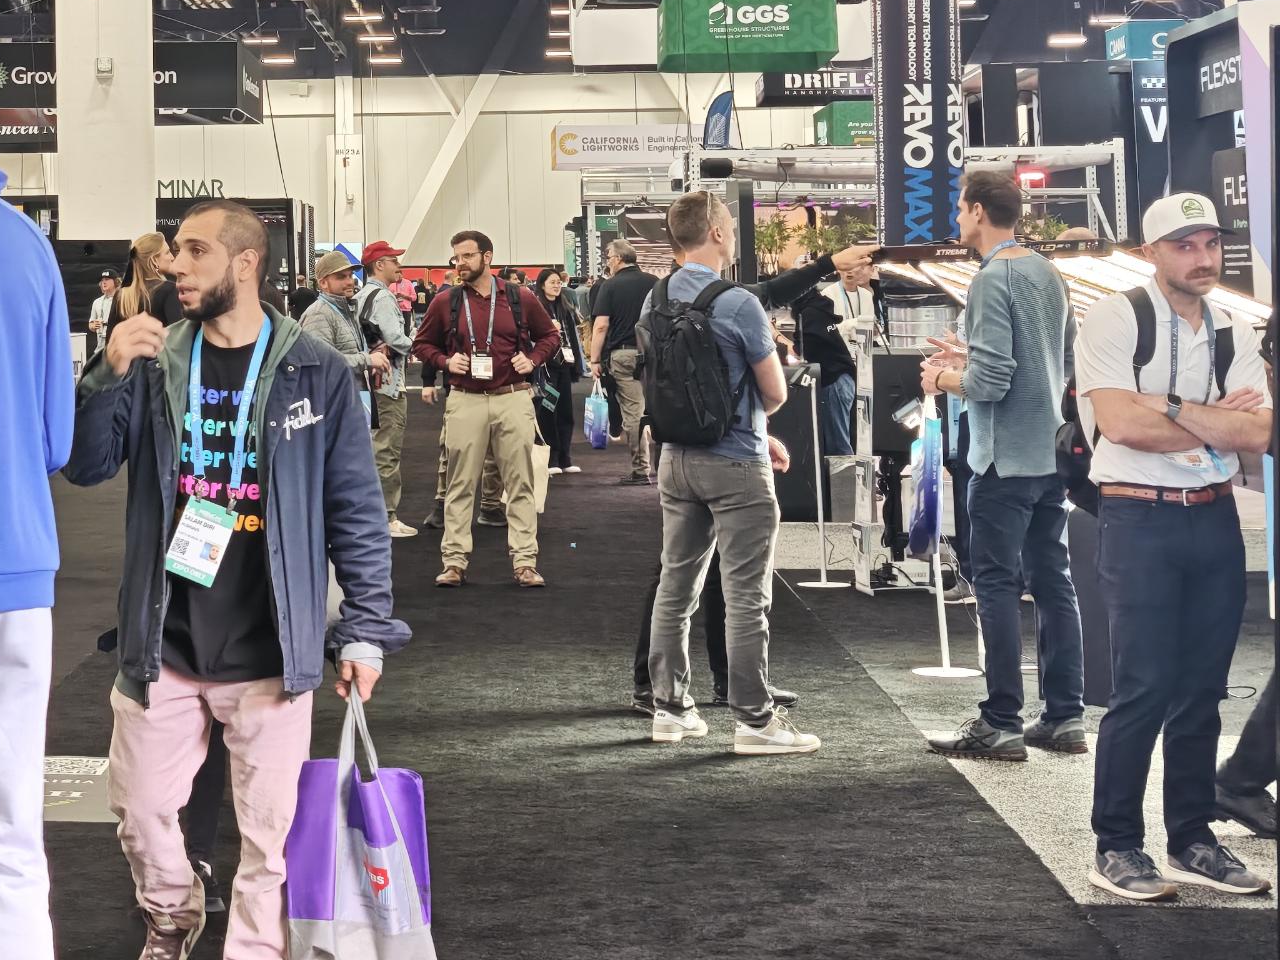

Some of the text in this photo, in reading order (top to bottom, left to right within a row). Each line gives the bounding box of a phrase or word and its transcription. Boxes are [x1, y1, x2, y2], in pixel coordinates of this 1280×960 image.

[736, 4, 790, 24] GGS
[908, 24, 916, 81] TECHNOLOGY
[923, 25, 931, 81] TECHNOLOGY
[1200, 55, 1242, 93] FLEXST
[581, 136, 639, 144] CALIFORNIA
[582, 144, 640, 152] LIGHTWORKS
[1223, 174, 1247, 207] FLE
[935, 247, 968, 256] XTREME
